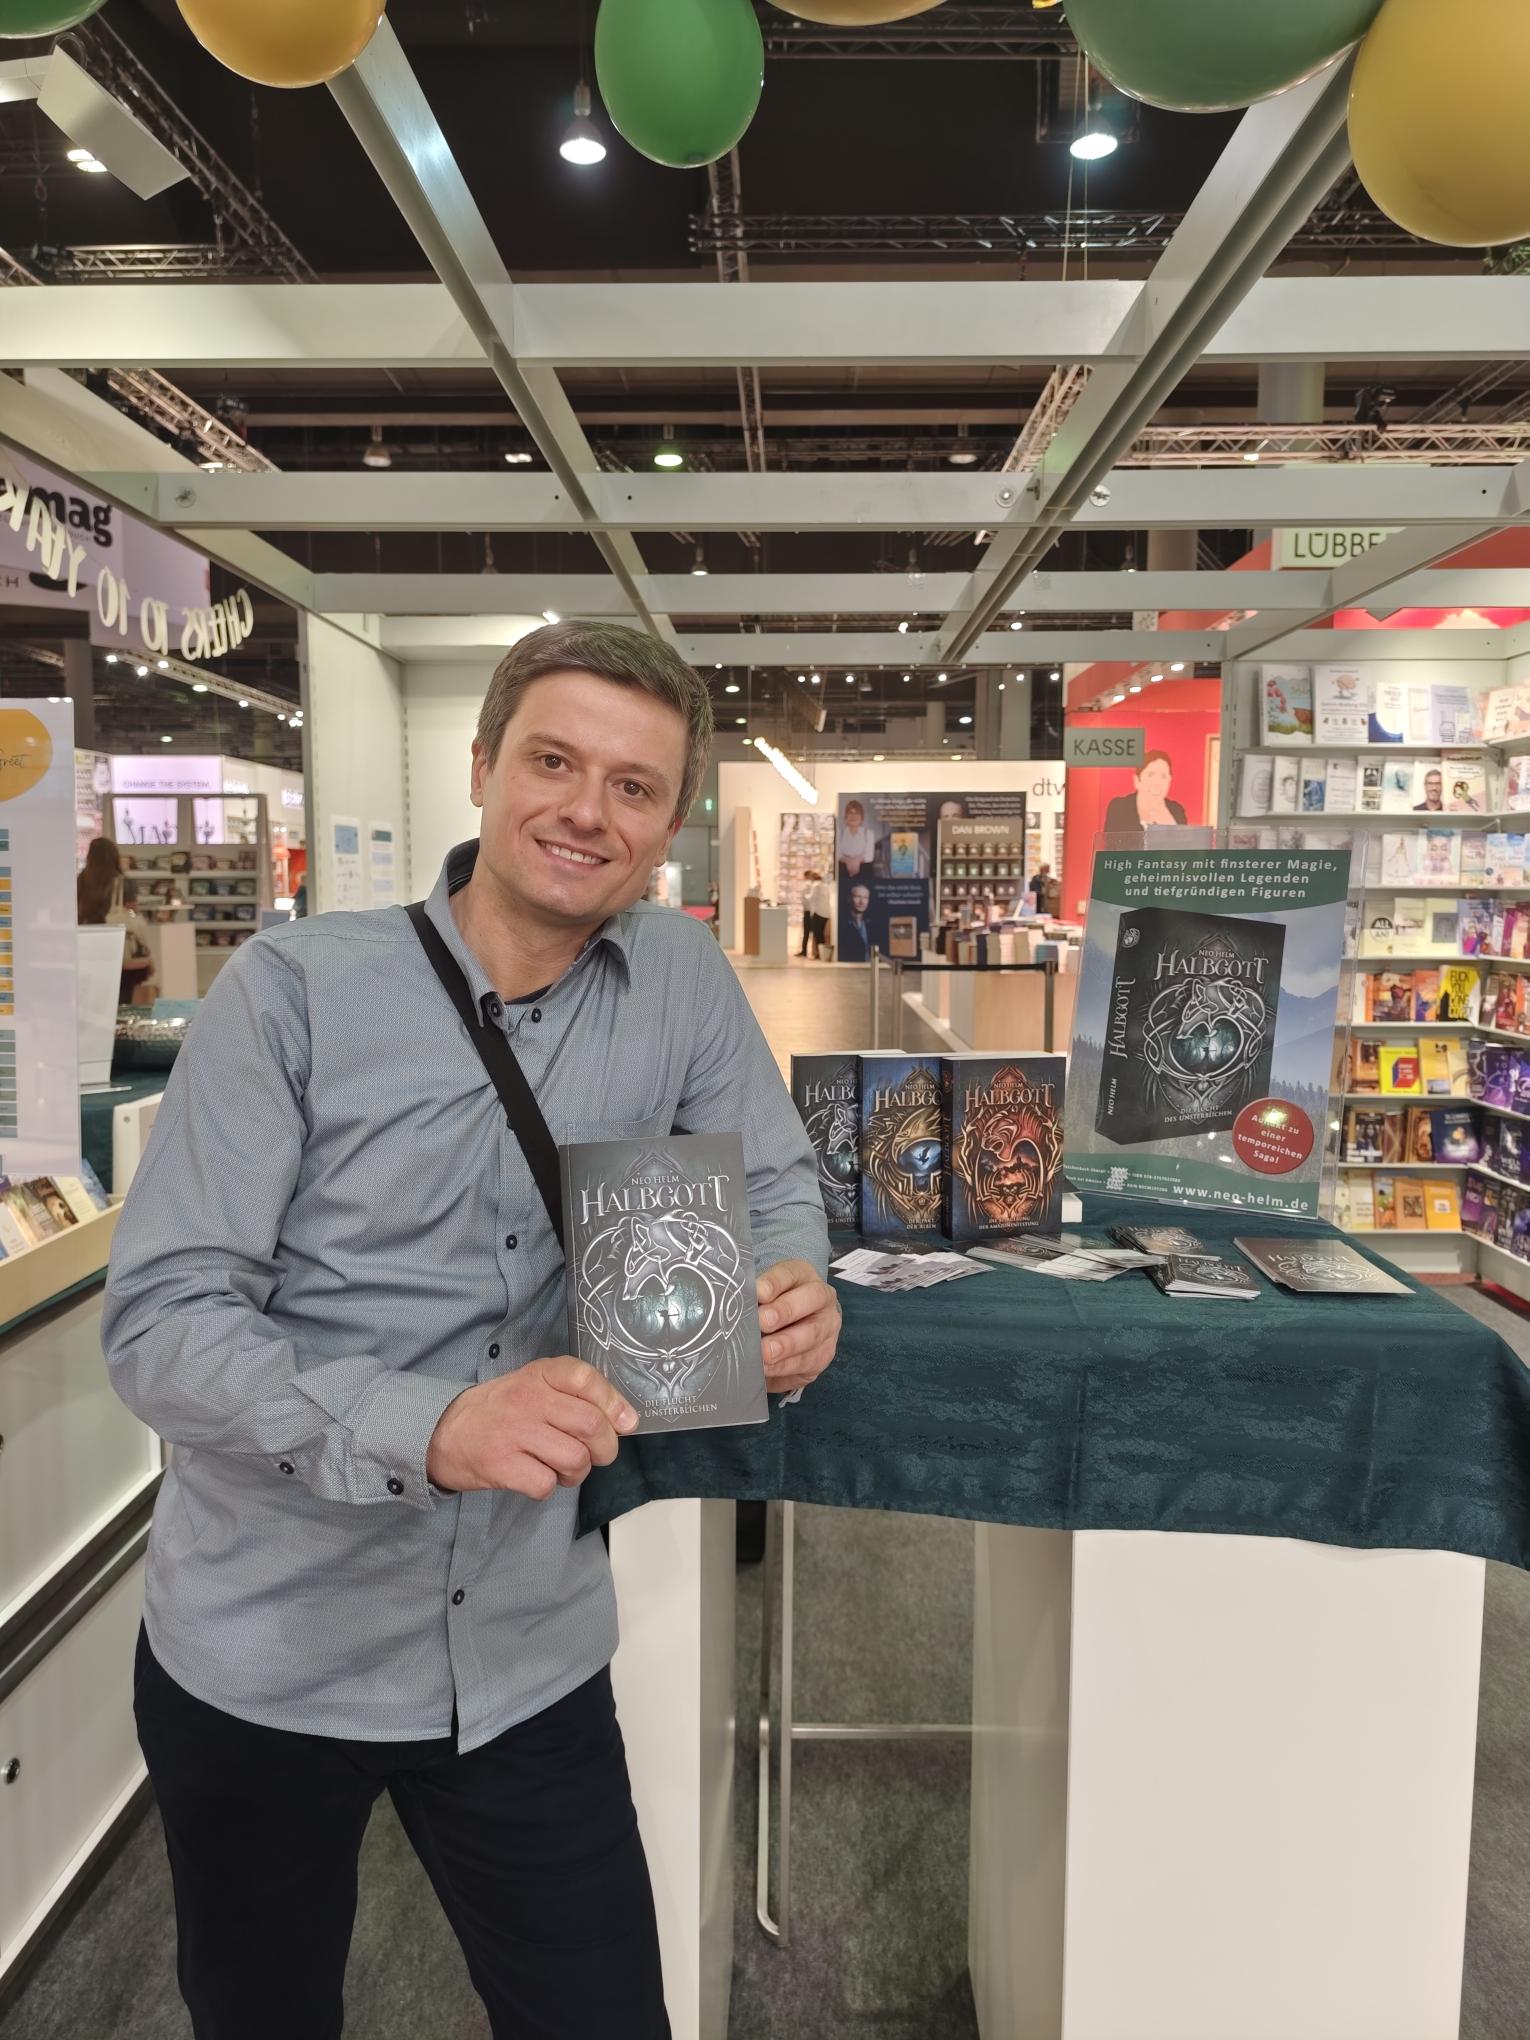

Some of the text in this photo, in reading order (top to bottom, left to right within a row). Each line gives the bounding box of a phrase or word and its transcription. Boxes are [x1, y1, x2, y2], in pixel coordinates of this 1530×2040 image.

[1074, 739, 1136, 756] KASSE
[1032, 778, 1066, 797] dtv
[952, 825, 1010, 835] DAN BROWN
[1104, 858, 1337, 872] High Fantasy mit finsterer Magie,
[1124, 873, 1309, 885] geheimnisvollen Legenden
[1125, 886, 1306, 899] und tiefgründigen Figuren
[1261, 1130, 1286, 1143] einer
[1288, 1126, 1300, 1135] zu
[1238, 1133, 1303, 1159] temporeichen
[1253, 1150, 1280, 1164] Saga!
[631, 1175, 680, 1185] NEO HELM
[580, 1175, 730, 1225] HALBGOTT
[1173, 1185, 1309, 1211] www.neo-helm.de
[645, 1396, 697, 1408] DIE FLUCHT
[644, 1403, 718, 1418] UNSTERBLICHEN
